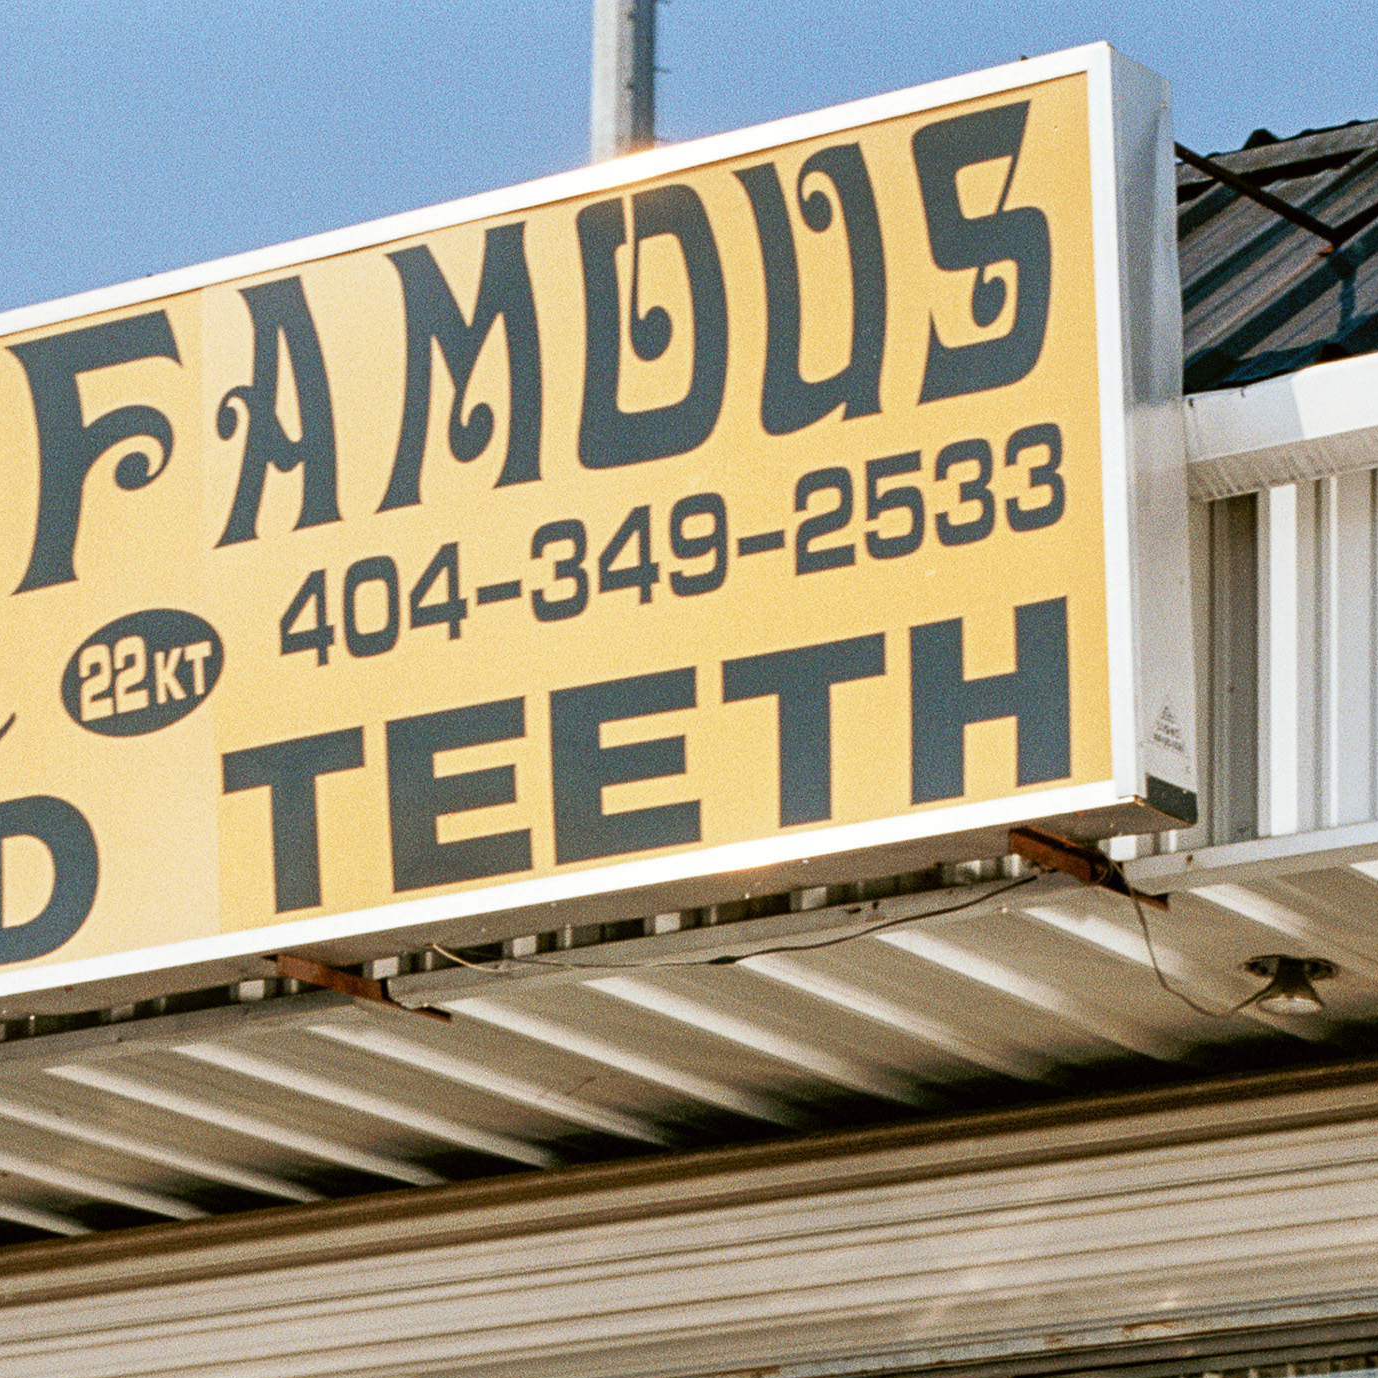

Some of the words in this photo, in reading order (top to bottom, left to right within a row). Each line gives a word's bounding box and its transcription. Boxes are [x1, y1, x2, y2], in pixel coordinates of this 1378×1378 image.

[9, 99, 1053, 595] FAMOUS
[280, 421, 1066, 667] 404-349-2533
[223, 596, 1072, 914] TEETH
